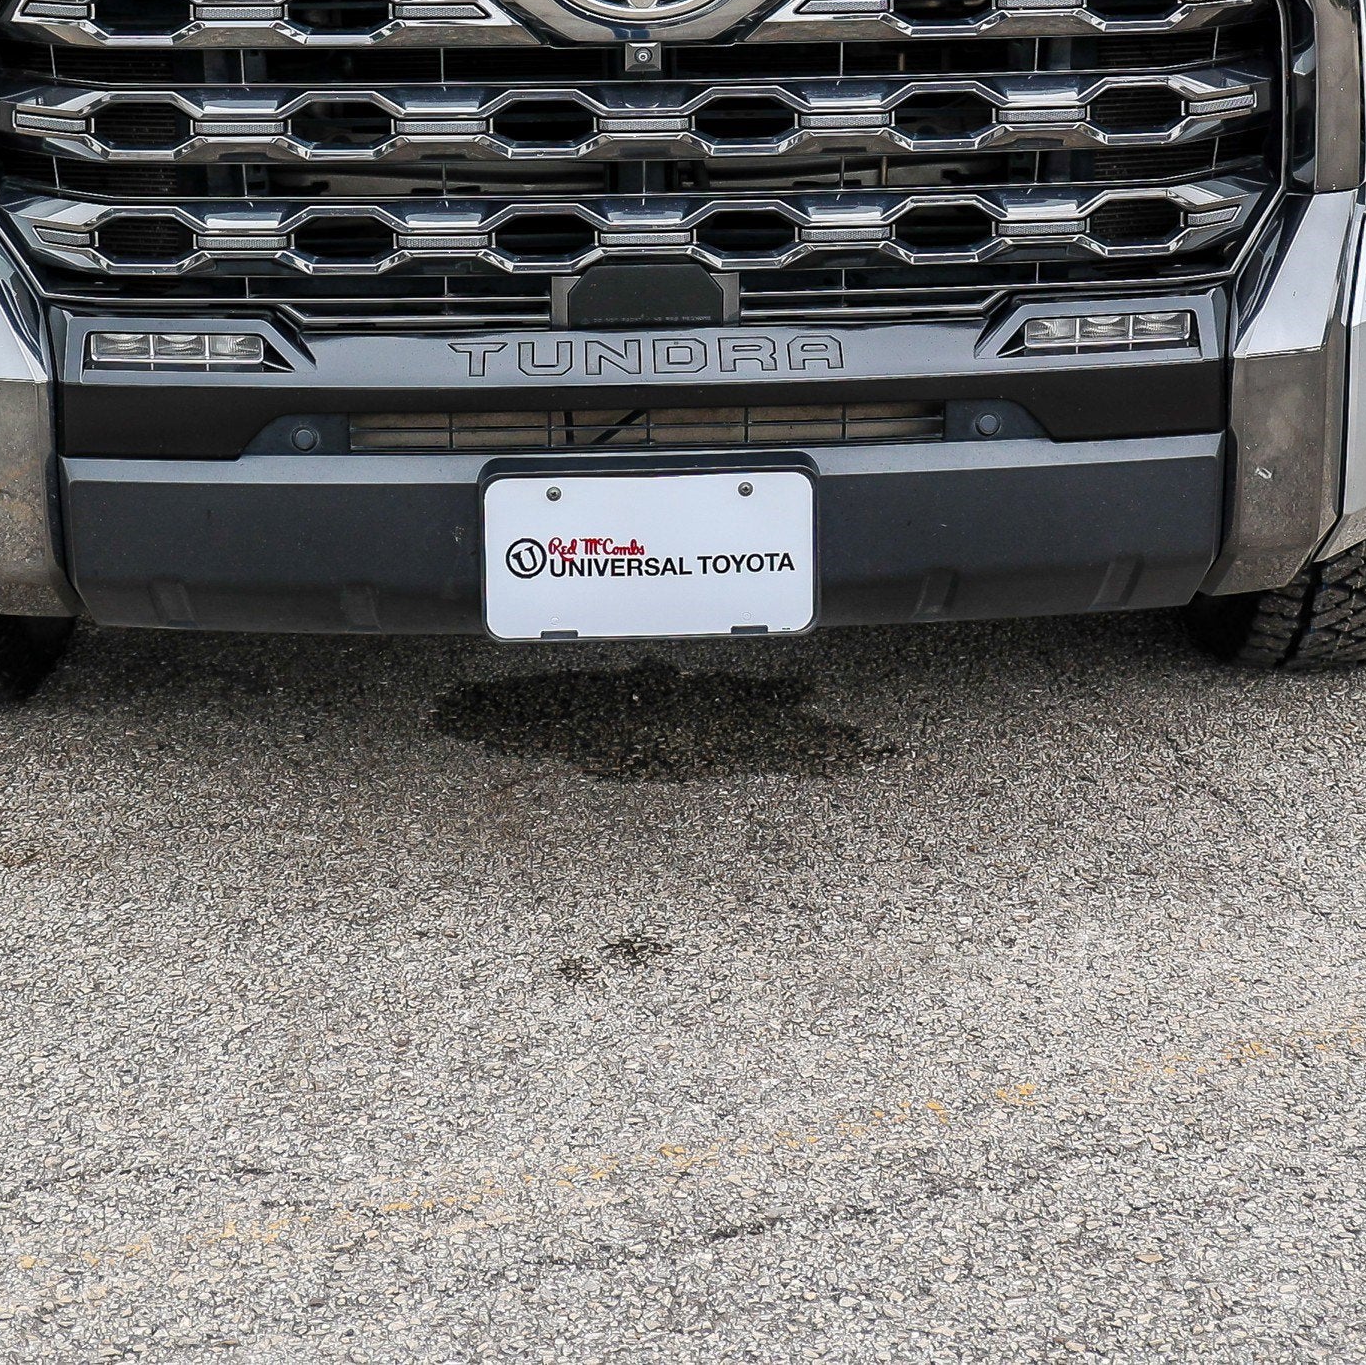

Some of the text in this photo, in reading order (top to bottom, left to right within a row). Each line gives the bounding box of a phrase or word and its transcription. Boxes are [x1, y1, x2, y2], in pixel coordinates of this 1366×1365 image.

[448, 334, 845, 377] TUNDRA
[548, 537, 645, 562] Red McCombs
[549, 552, 796, 578] UNIVERSAL TOYOTA
